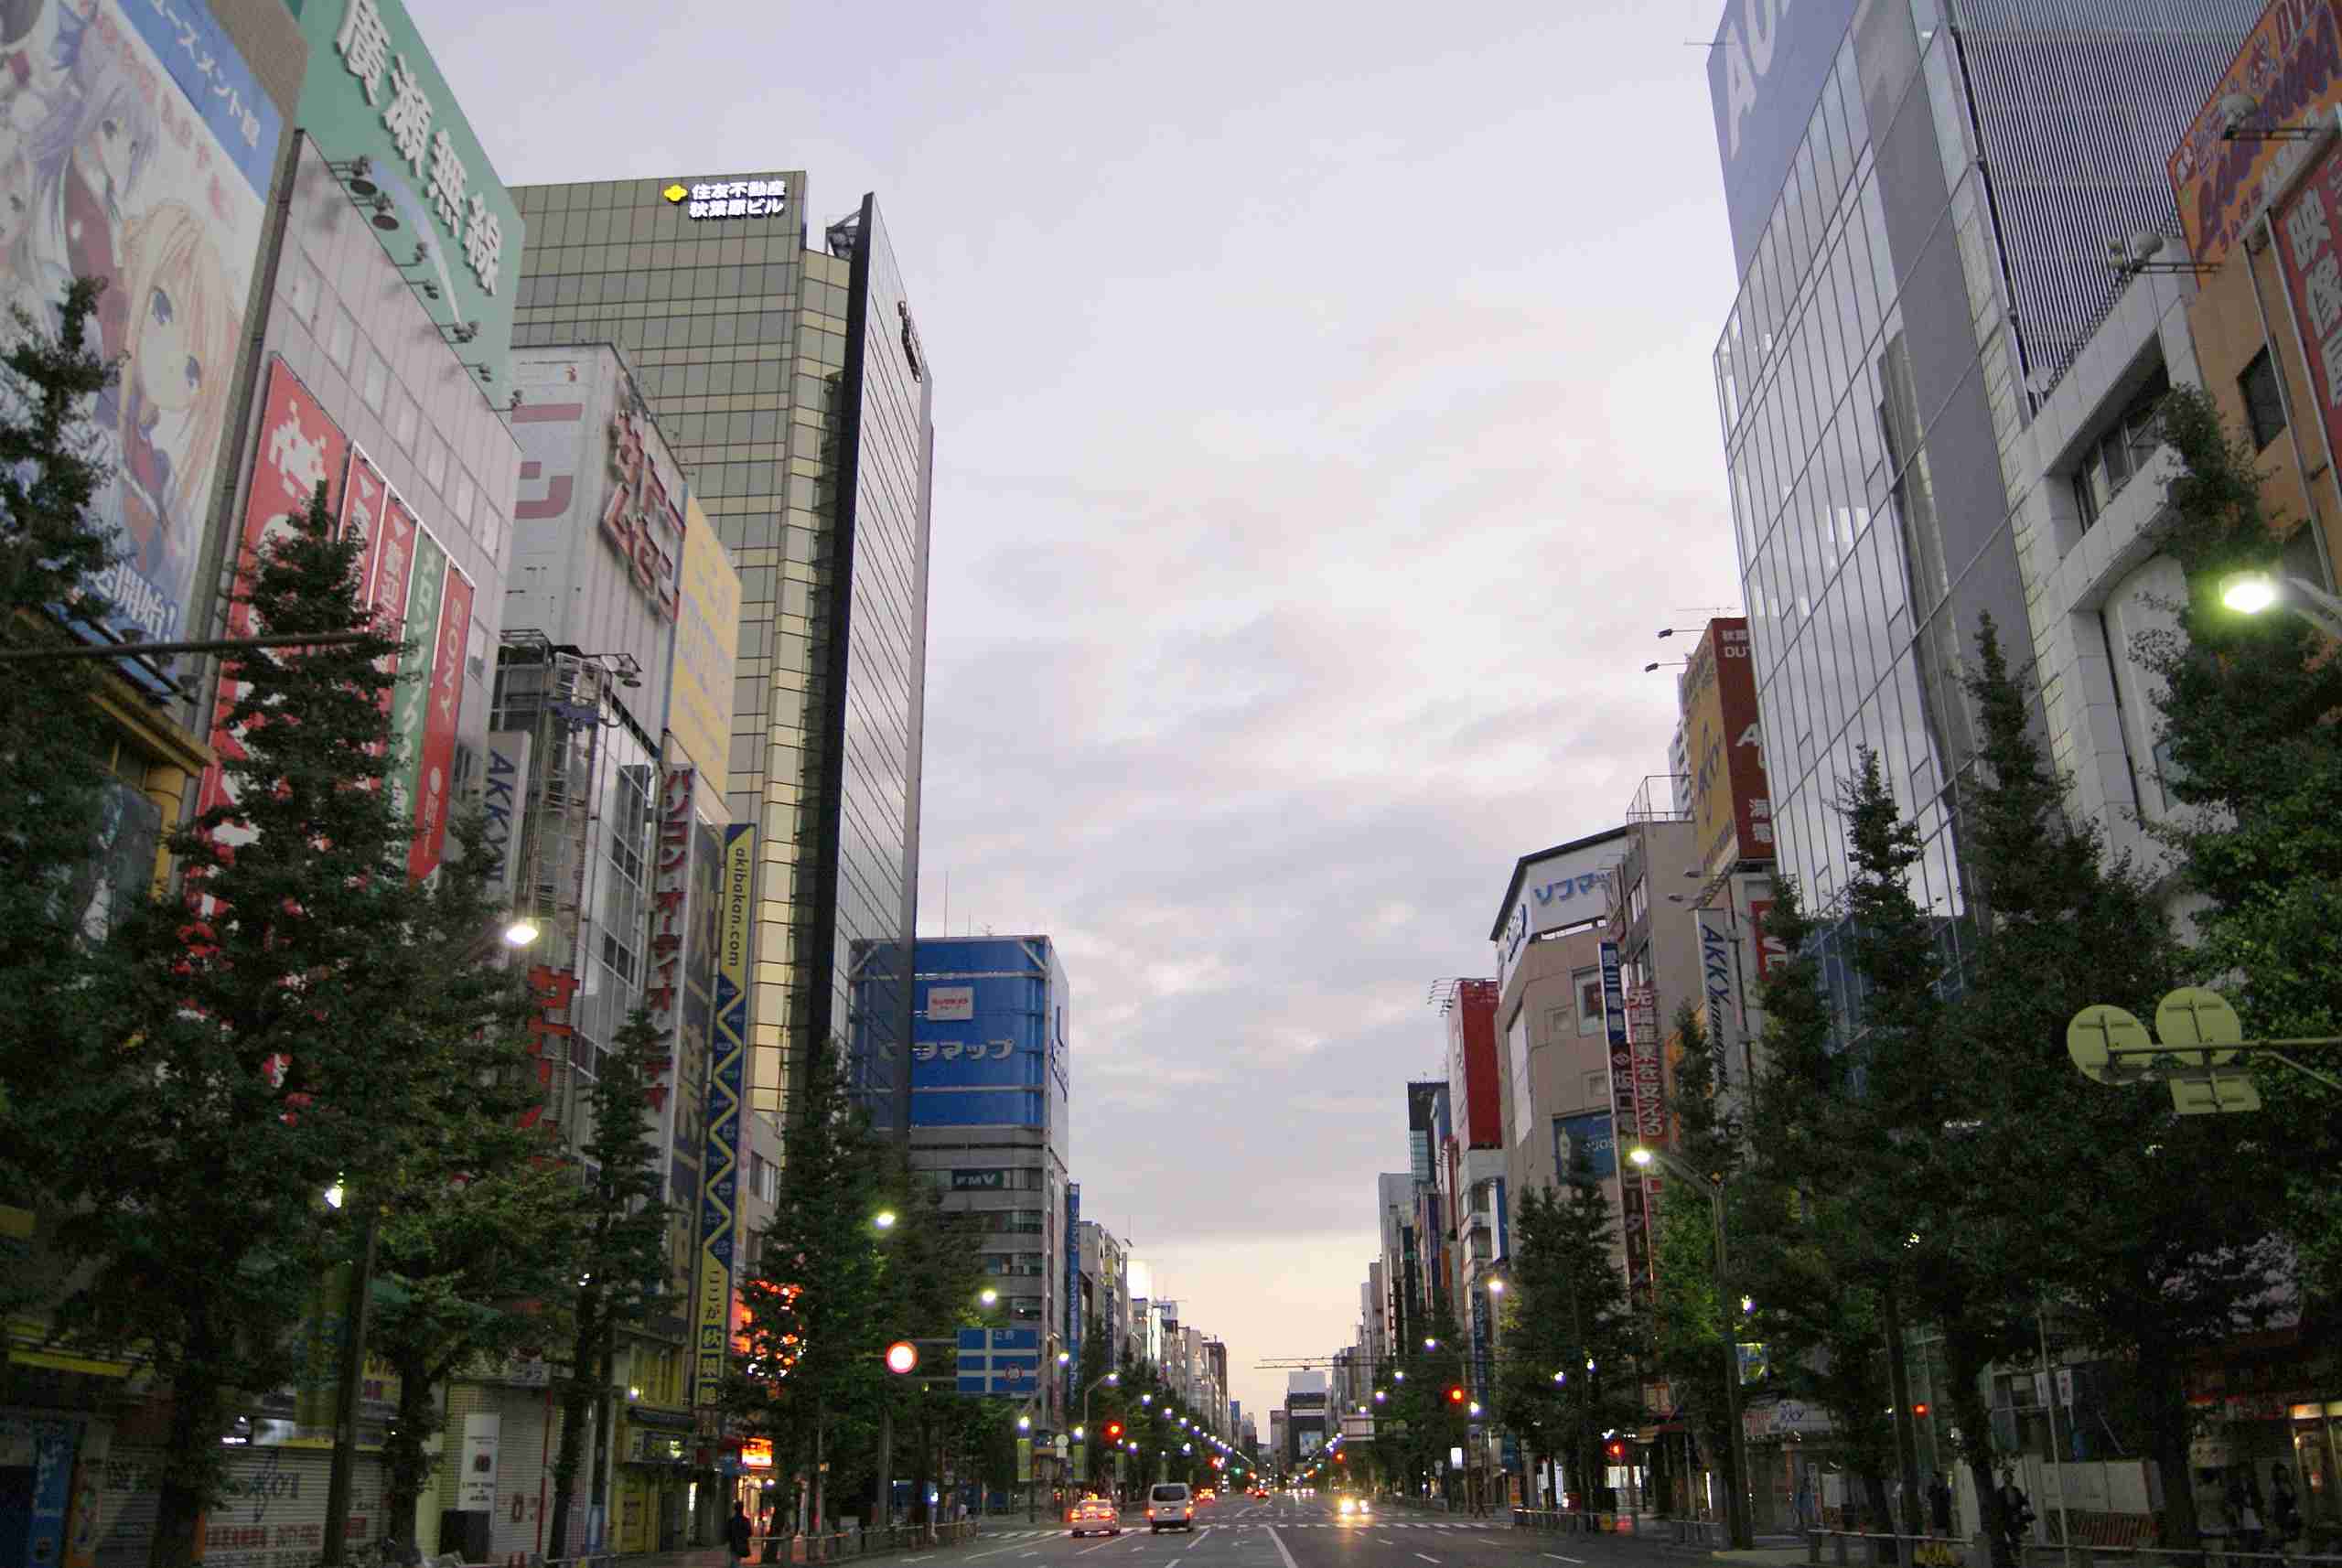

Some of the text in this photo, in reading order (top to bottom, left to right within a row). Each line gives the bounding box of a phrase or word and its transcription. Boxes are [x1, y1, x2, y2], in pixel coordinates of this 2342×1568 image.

[1724, 0, 1792, 162] AO
[689, 199, 784, 219] 秋葉原ビル
[691, 180, 786, 200] 住友不動産
[440, 597, 463, 721] SONY
[728, 847, 750, 968] akibakan.com
[1702, 924, 1732, 1006] AKKY
